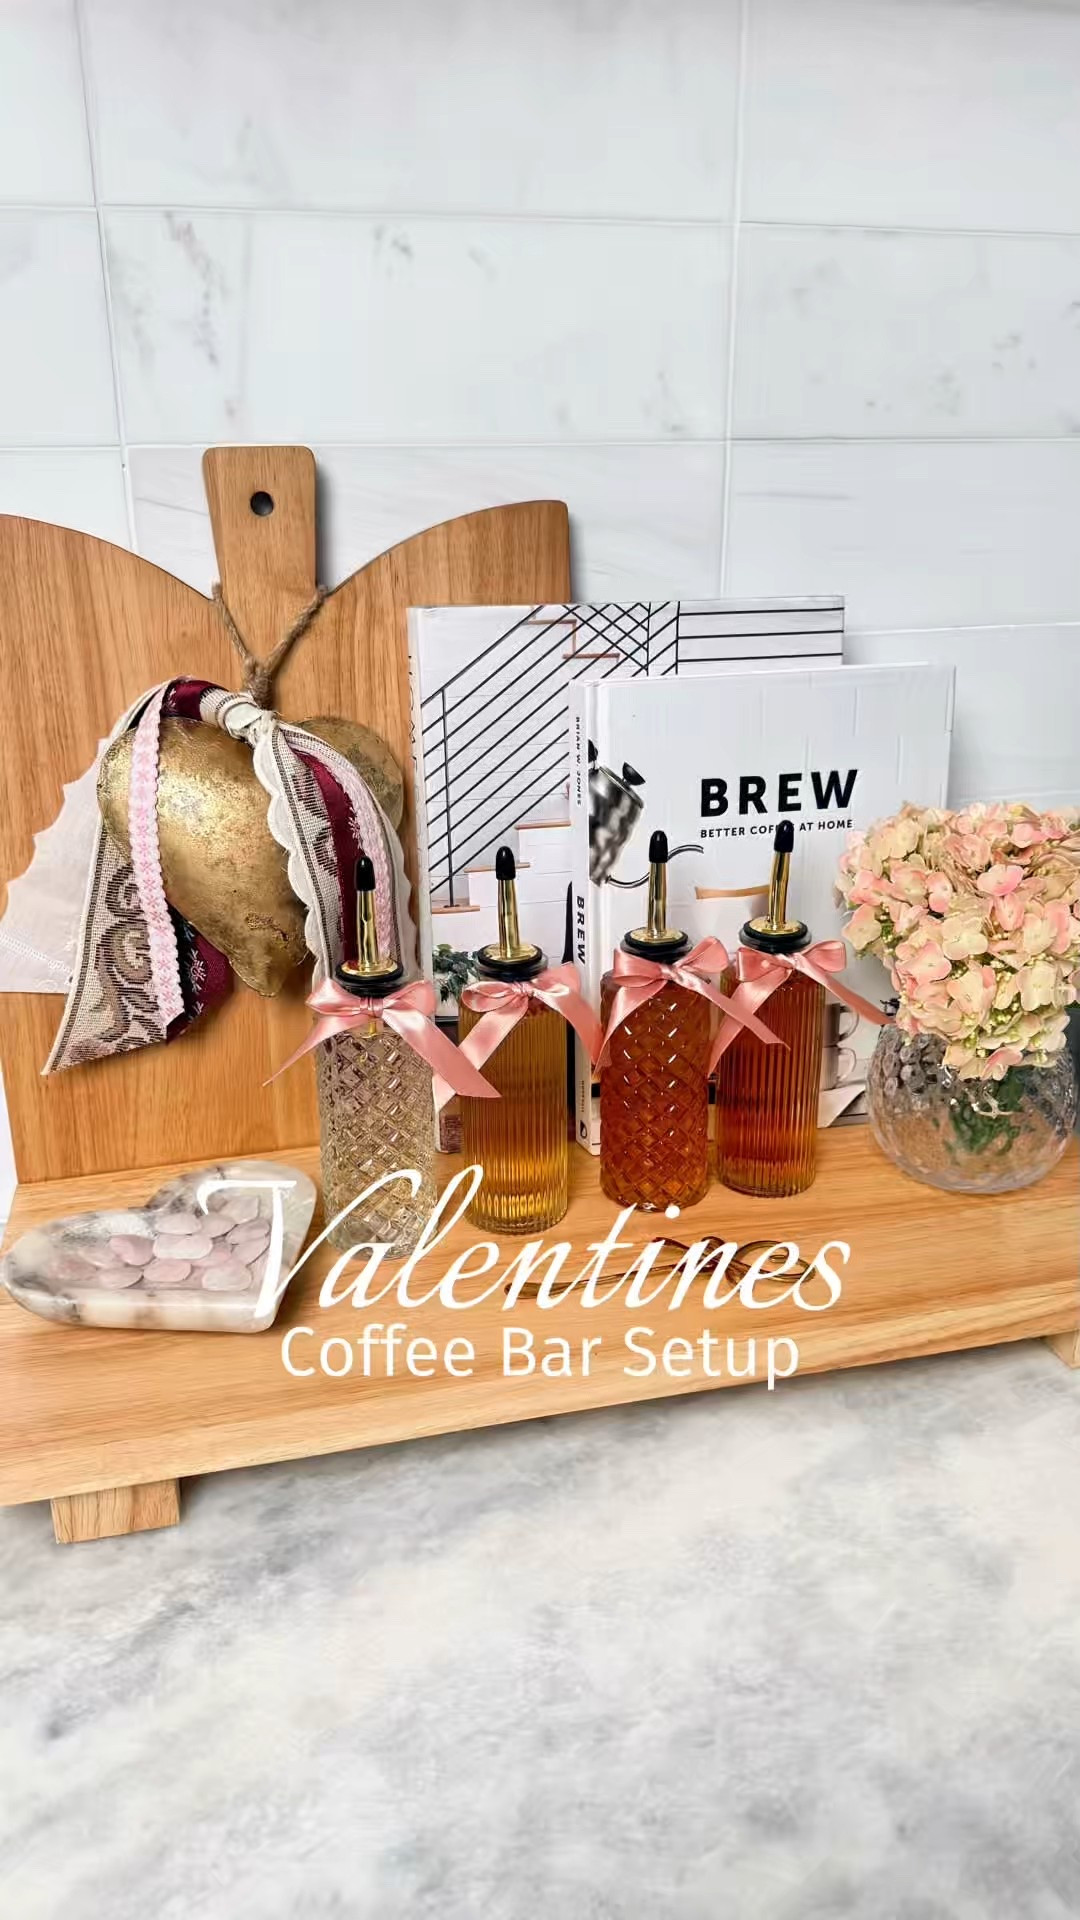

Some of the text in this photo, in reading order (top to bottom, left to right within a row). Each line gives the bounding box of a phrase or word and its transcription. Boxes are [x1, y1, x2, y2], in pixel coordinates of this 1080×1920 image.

[700, 769, 858, 817] BREW
[700, 826, 746, 838] BETTER
[799, 822, 814, 832] AT
[818, 819, 853, 830] HOME
[577, 895, 586, 965] BREW
